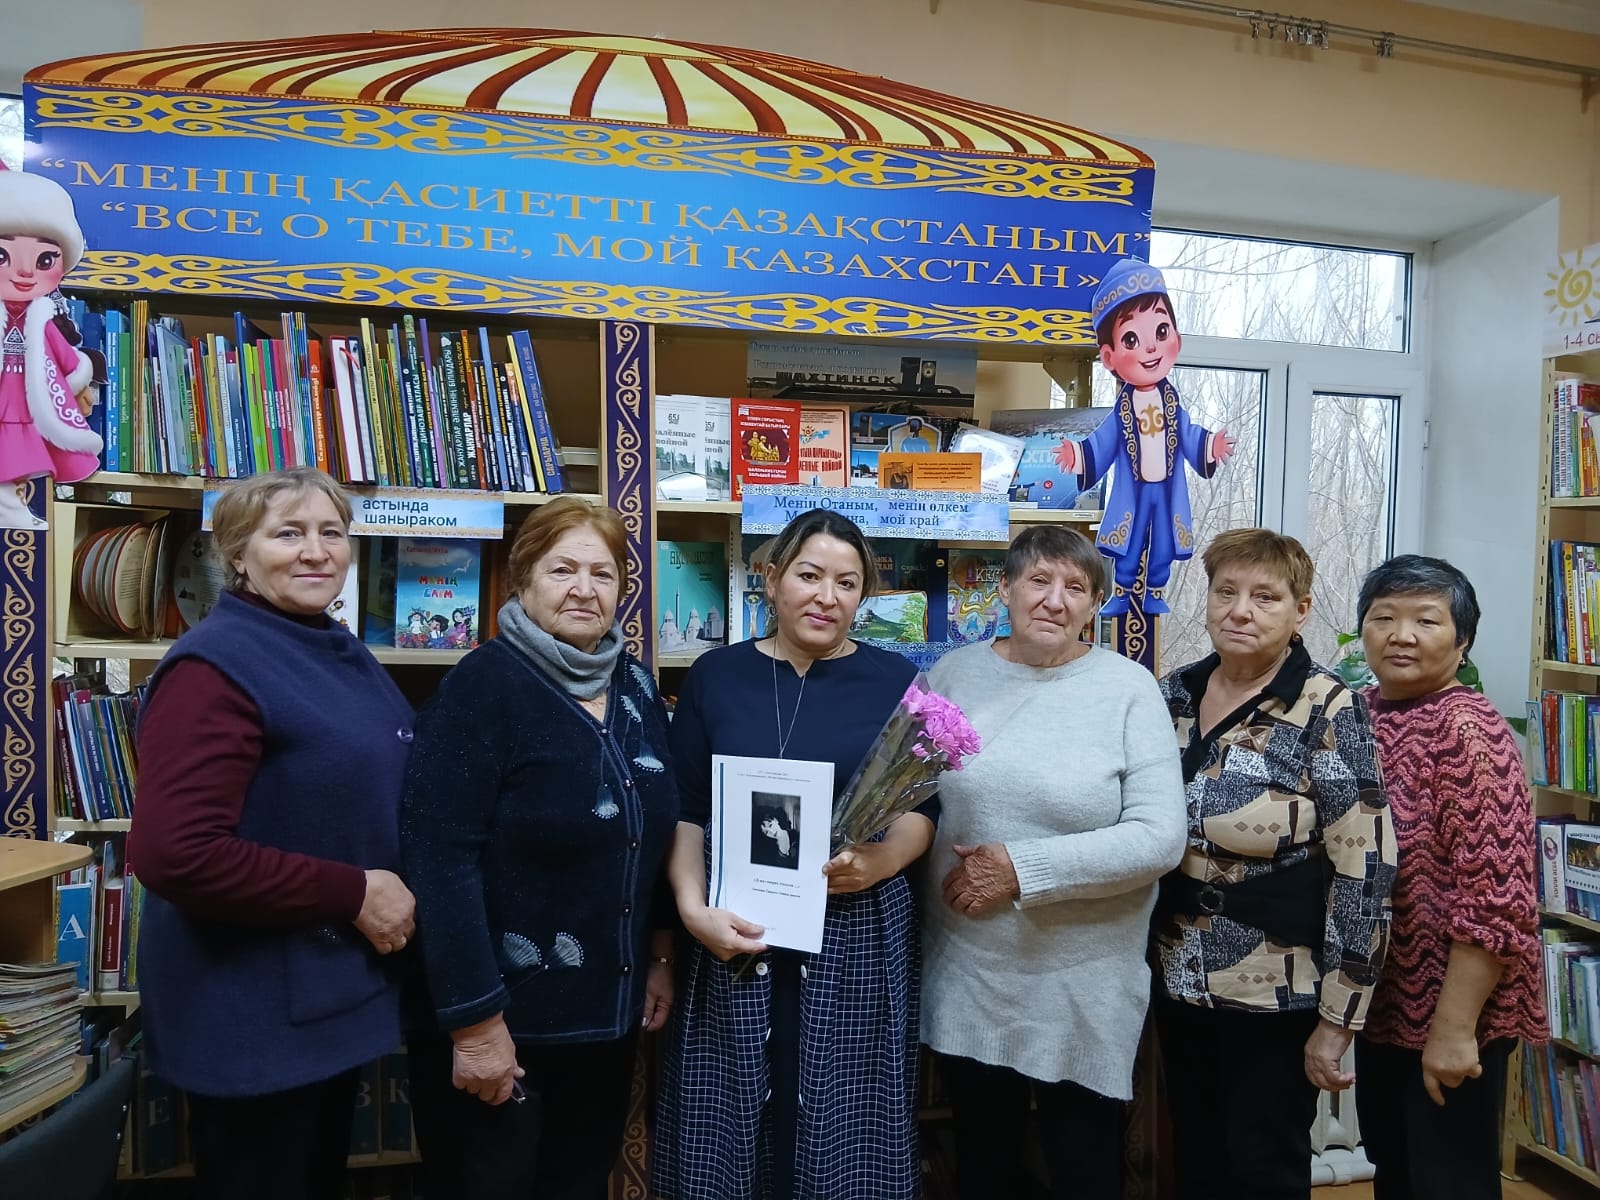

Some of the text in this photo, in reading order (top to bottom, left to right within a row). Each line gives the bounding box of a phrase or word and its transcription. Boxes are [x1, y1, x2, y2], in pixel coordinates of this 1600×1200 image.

[40, 157, 1152, 257] “МЕНІҢ ҚАСИЕТТІ ҚАЗАҚСТАНЫМ”
[101, 200, 1101, 290] “ВСЕ О ТЕБЕ, МОЙ КАЗАХСТАН»
[775, 371, 897, 386] ШАХТИНСК
[412, 374, 428, 444] ДИНОЗАВР АТЛАСЫ
[453, 425, 466, 467] ЖАНУАРЛАР
[463, 412, 477, 459] ЖАНУАРЛАР
[362, 499, 429, 514] астында
[820, 497, 878, 512] Отаным,
[364, 513, 457, 527] шаныраком
[880, 514, 907, 526] мой
[909, 515, 941, 529] край
